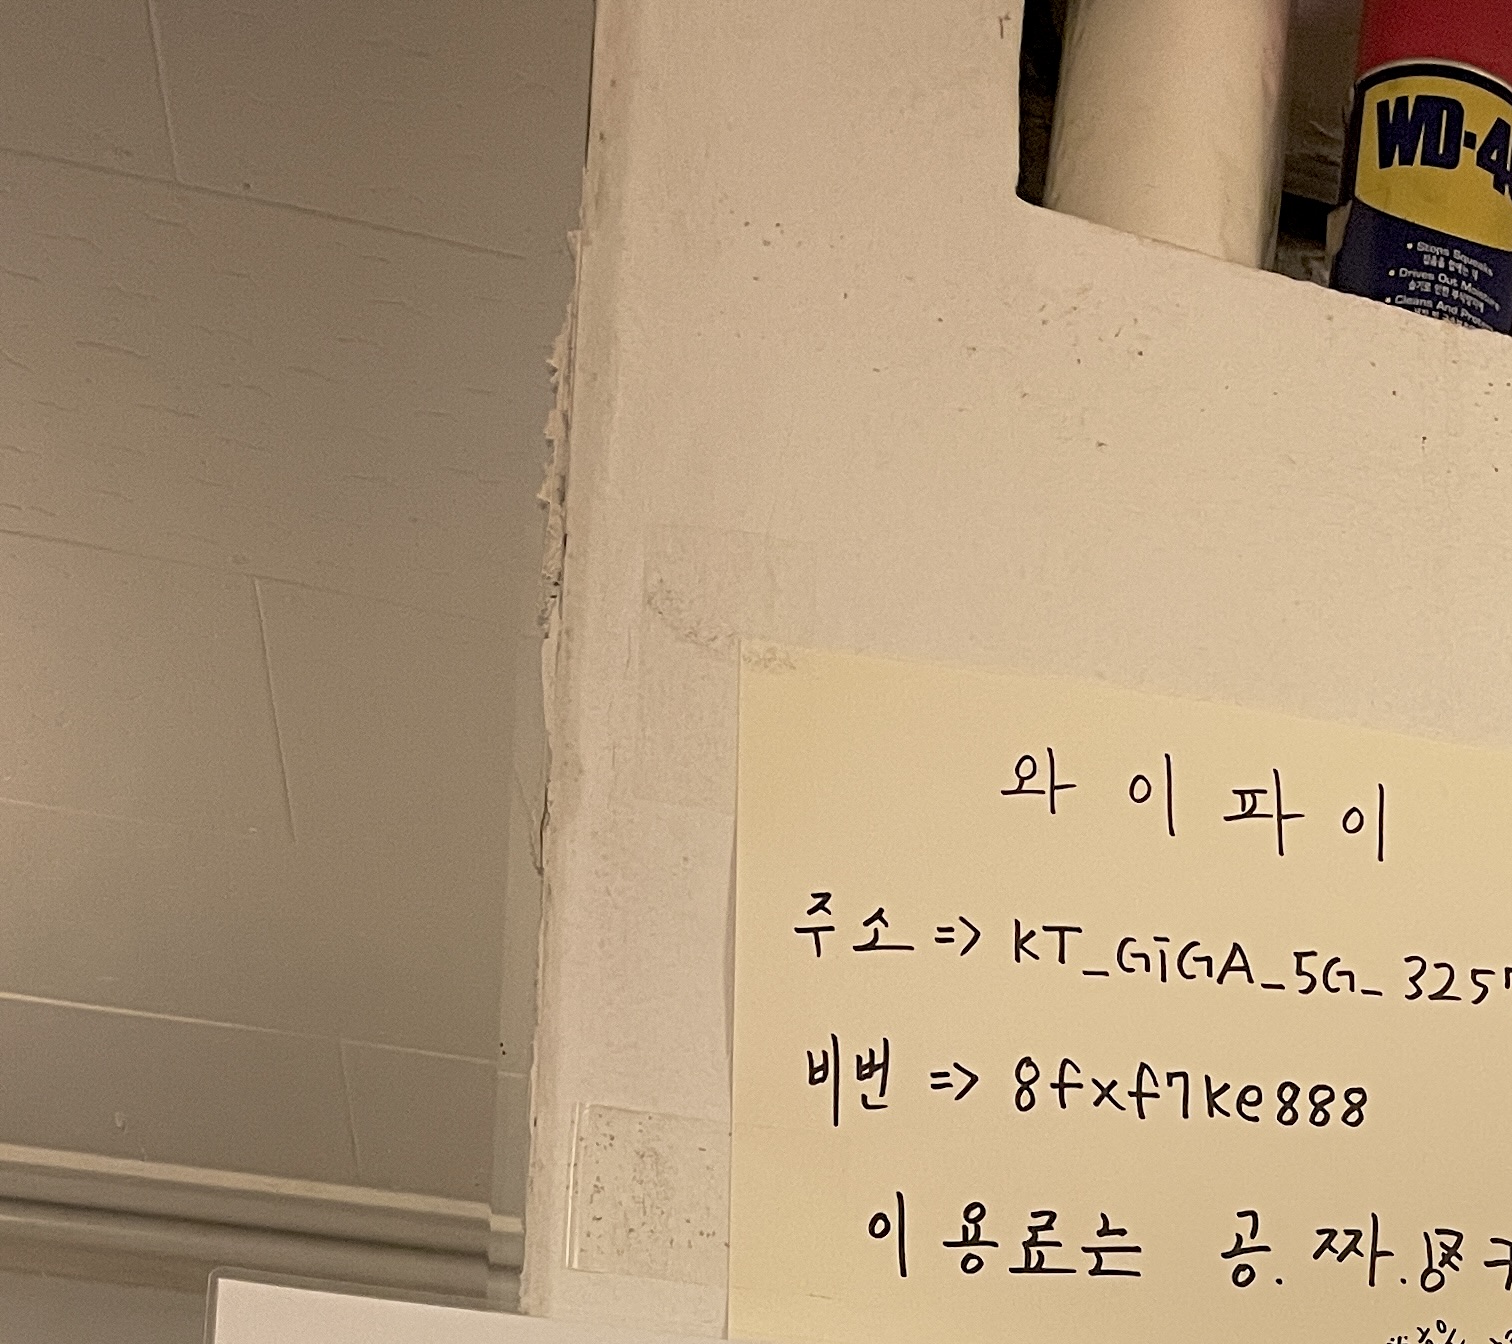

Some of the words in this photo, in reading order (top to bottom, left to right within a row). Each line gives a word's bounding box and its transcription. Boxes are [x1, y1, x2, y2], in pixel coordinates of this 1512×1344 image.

[1399, 267, 1435, 280] Drives
[793, 891, 915, 959] 주소
[806, 1032, 890, 1128] 비번
[867, 1190, 1143, 1278] 이용료는
